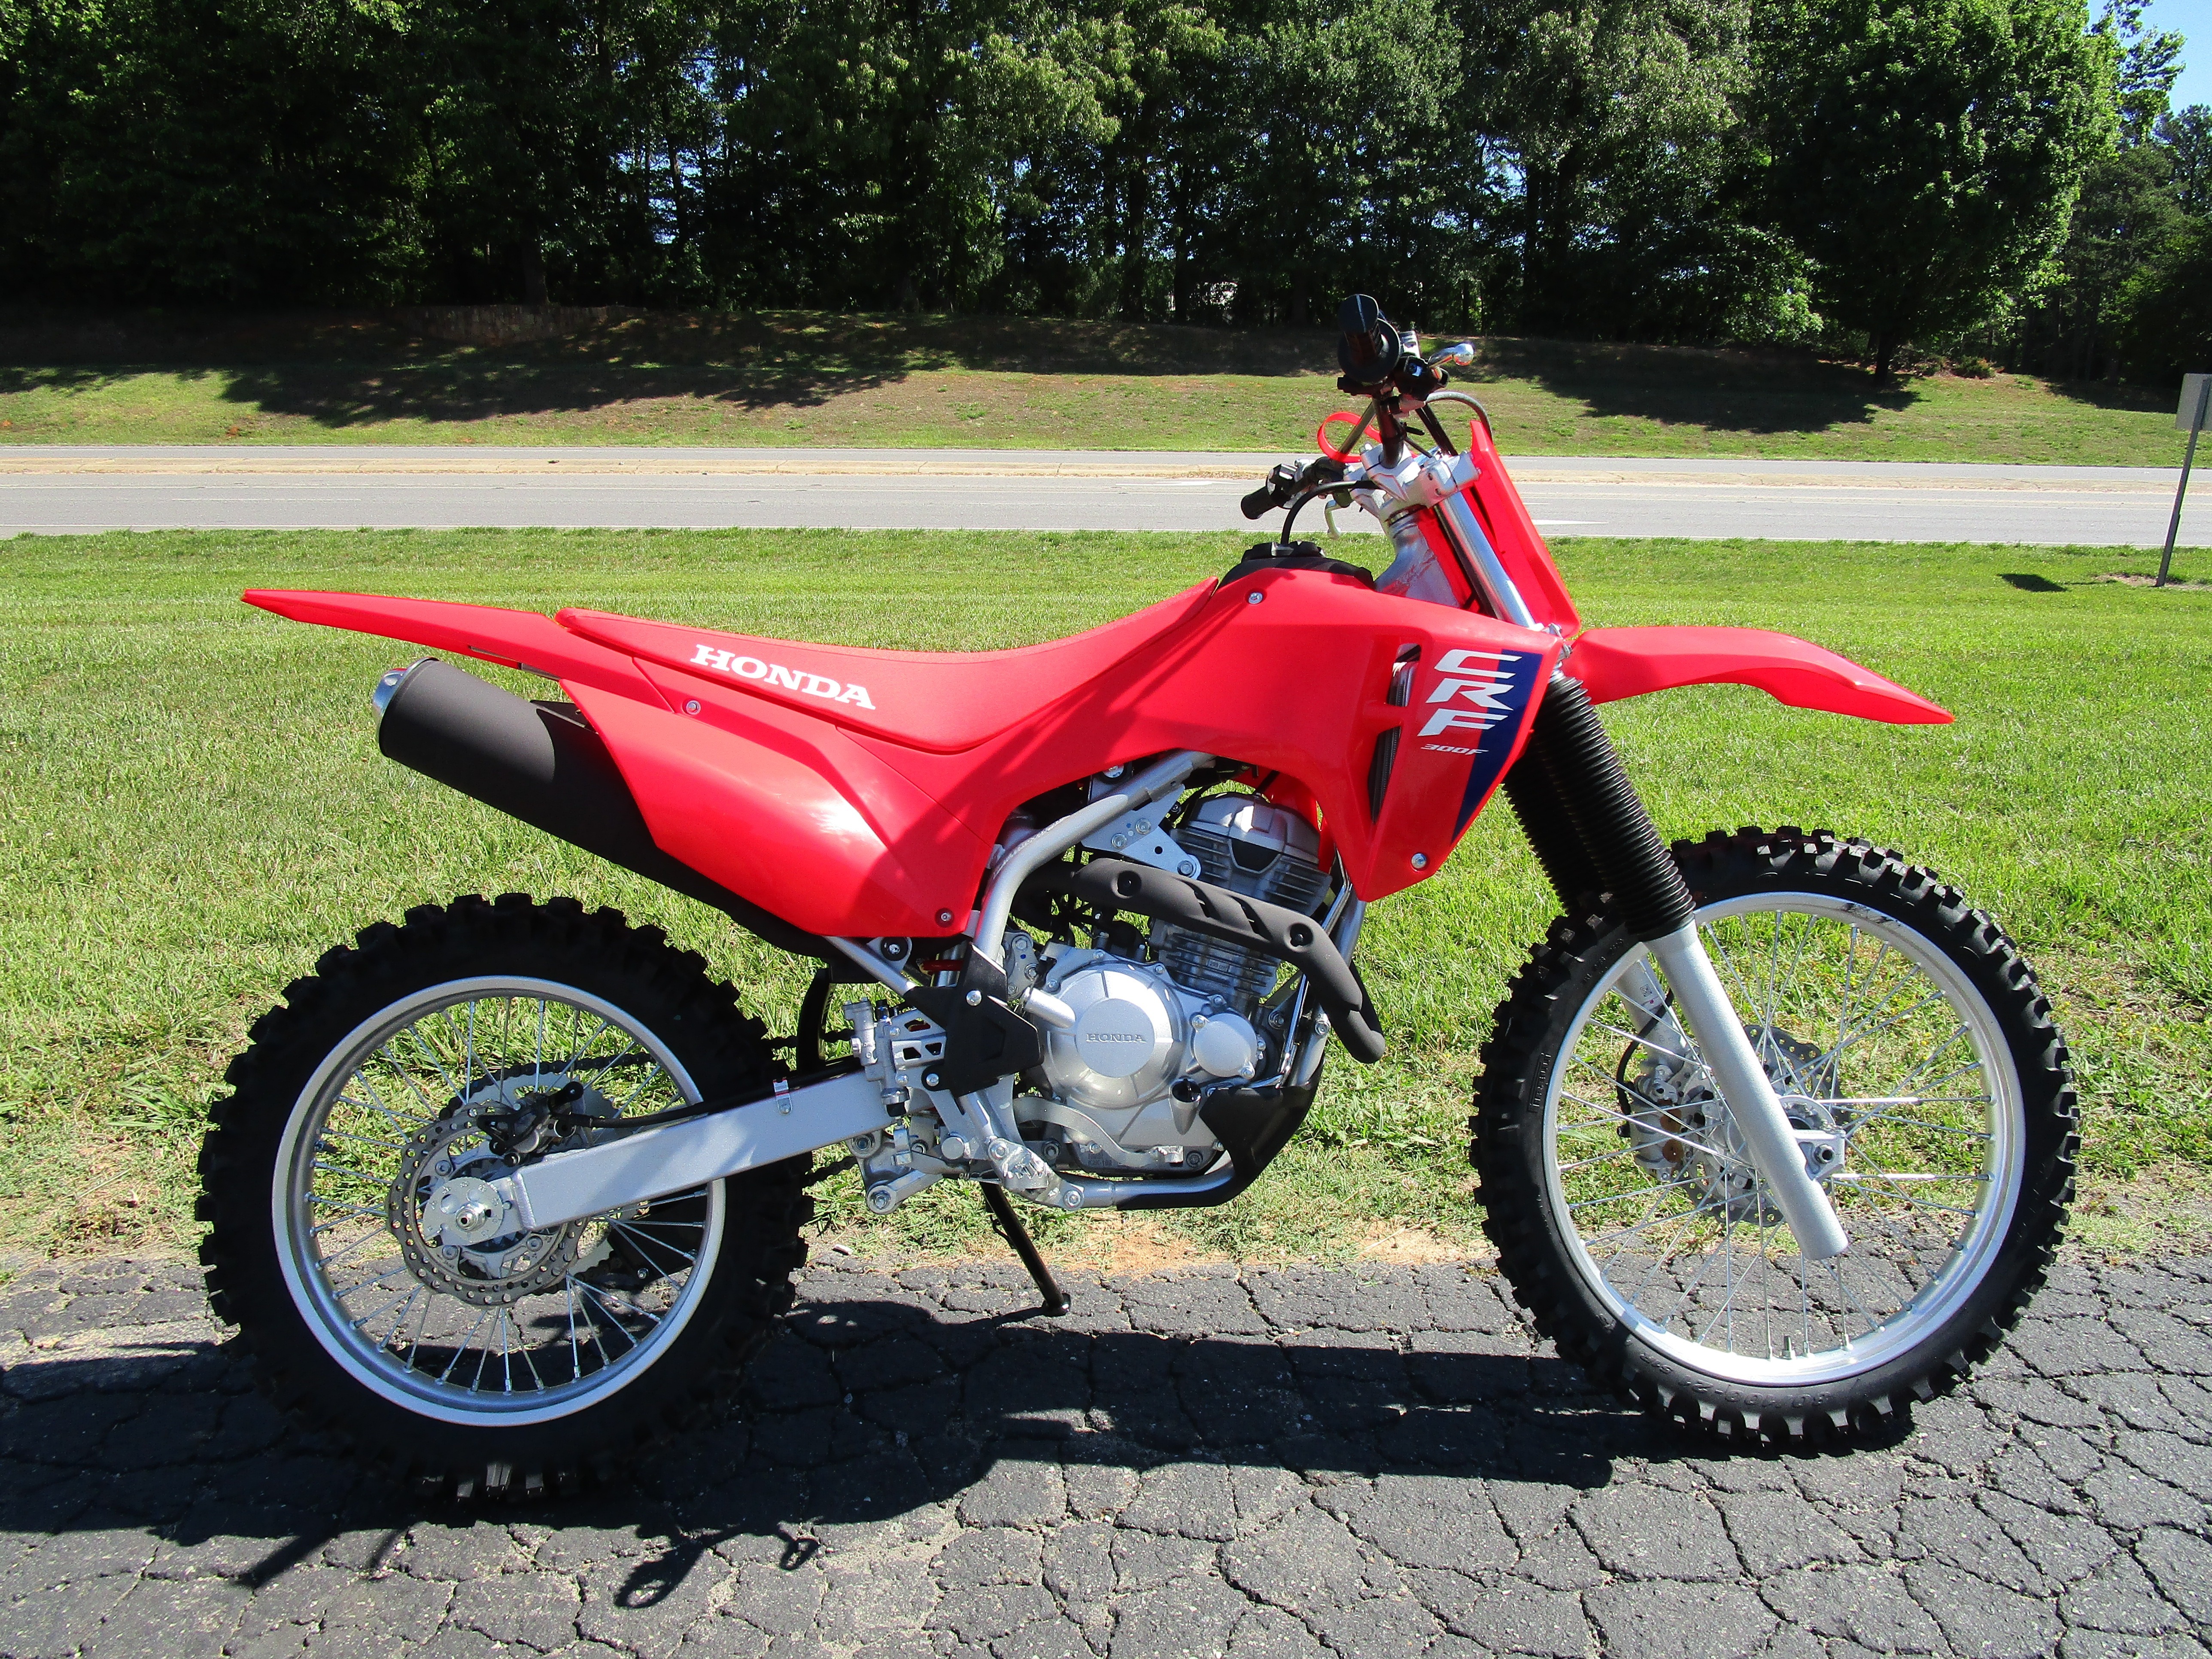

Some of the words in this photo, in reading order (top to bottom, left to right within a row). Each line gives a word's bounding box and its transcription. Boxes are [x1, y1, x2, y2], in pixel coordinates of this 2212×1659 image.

[690, 644, 876, 710] HONDA
[1417, 649, 1522, 737] CRF
[1420, 743, 1489, 755] 300F
[1086, 1033, 1147, 1043] HONDA
